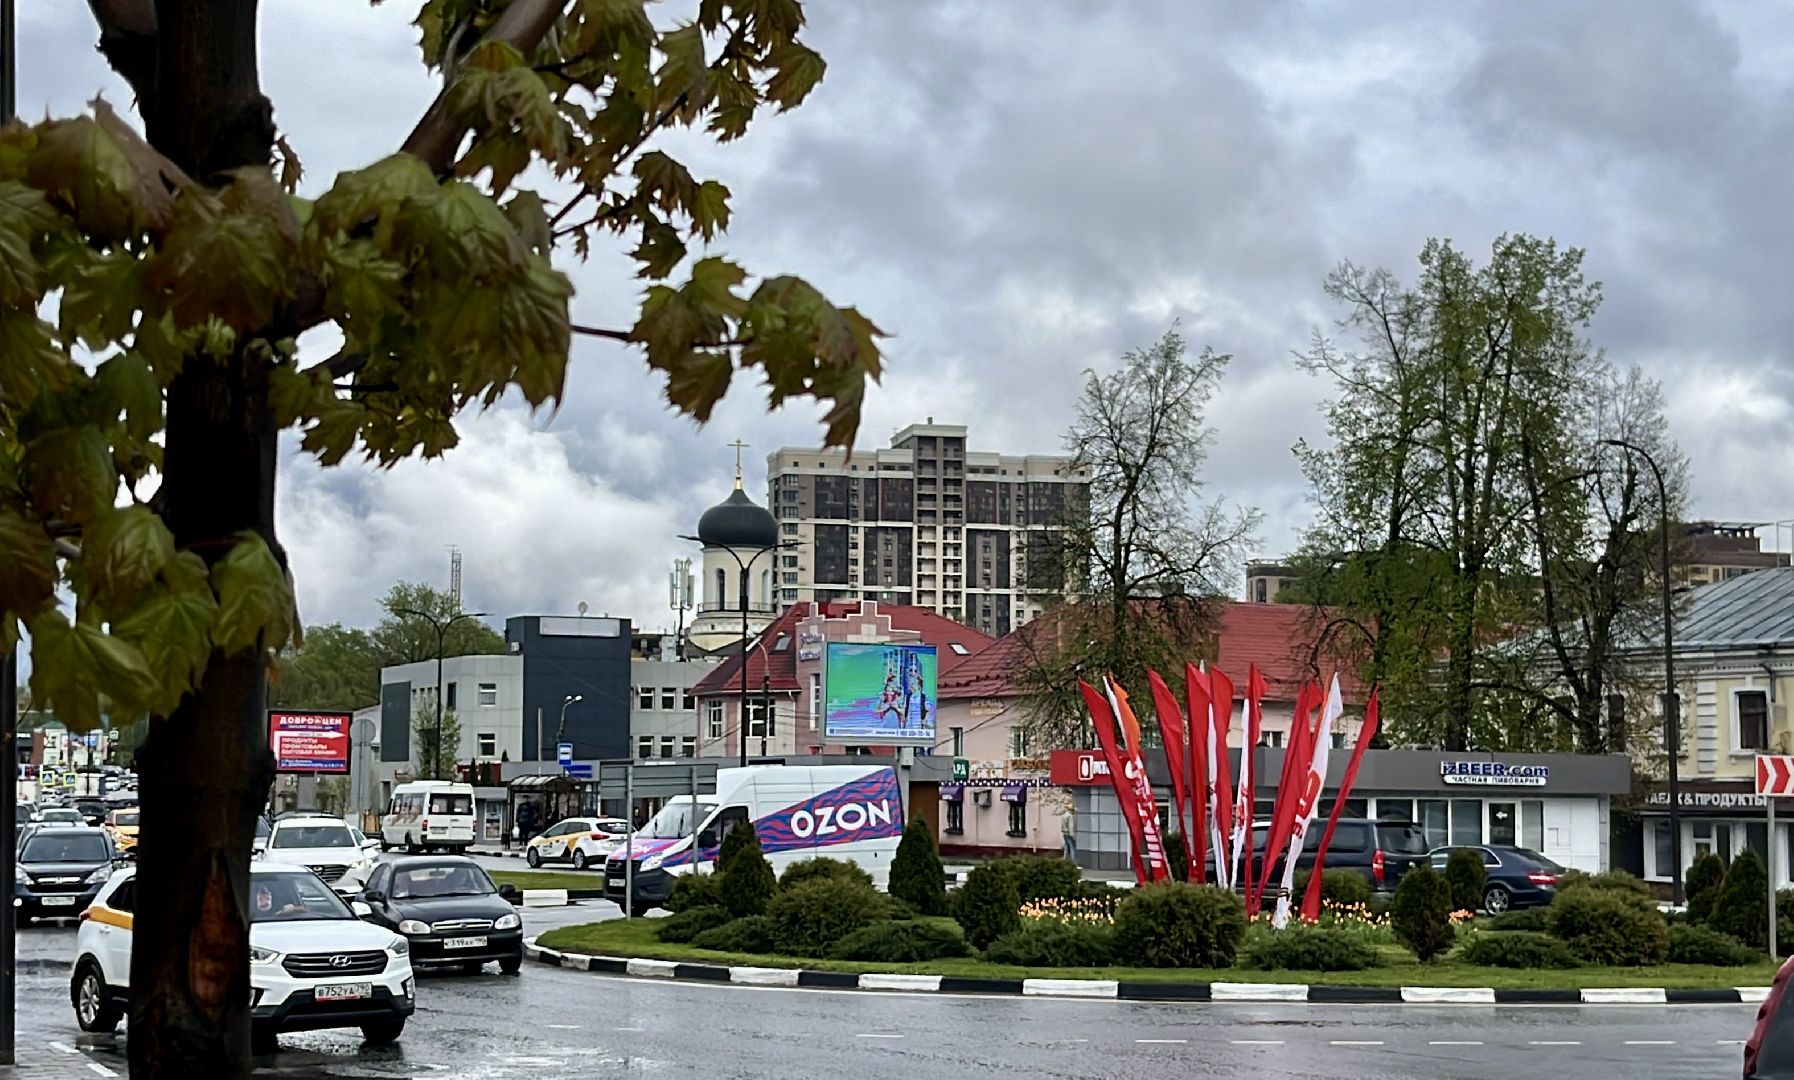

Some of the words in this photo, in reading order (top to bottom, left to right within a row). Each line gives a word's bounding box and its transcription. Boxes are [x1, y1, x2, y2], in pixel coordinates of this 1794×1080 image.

[1684, 793, 1693, 804] &
[1695, 793, 1767, 807] ПРОДУКТЫ
[790, 799, 893, 838] OZON
